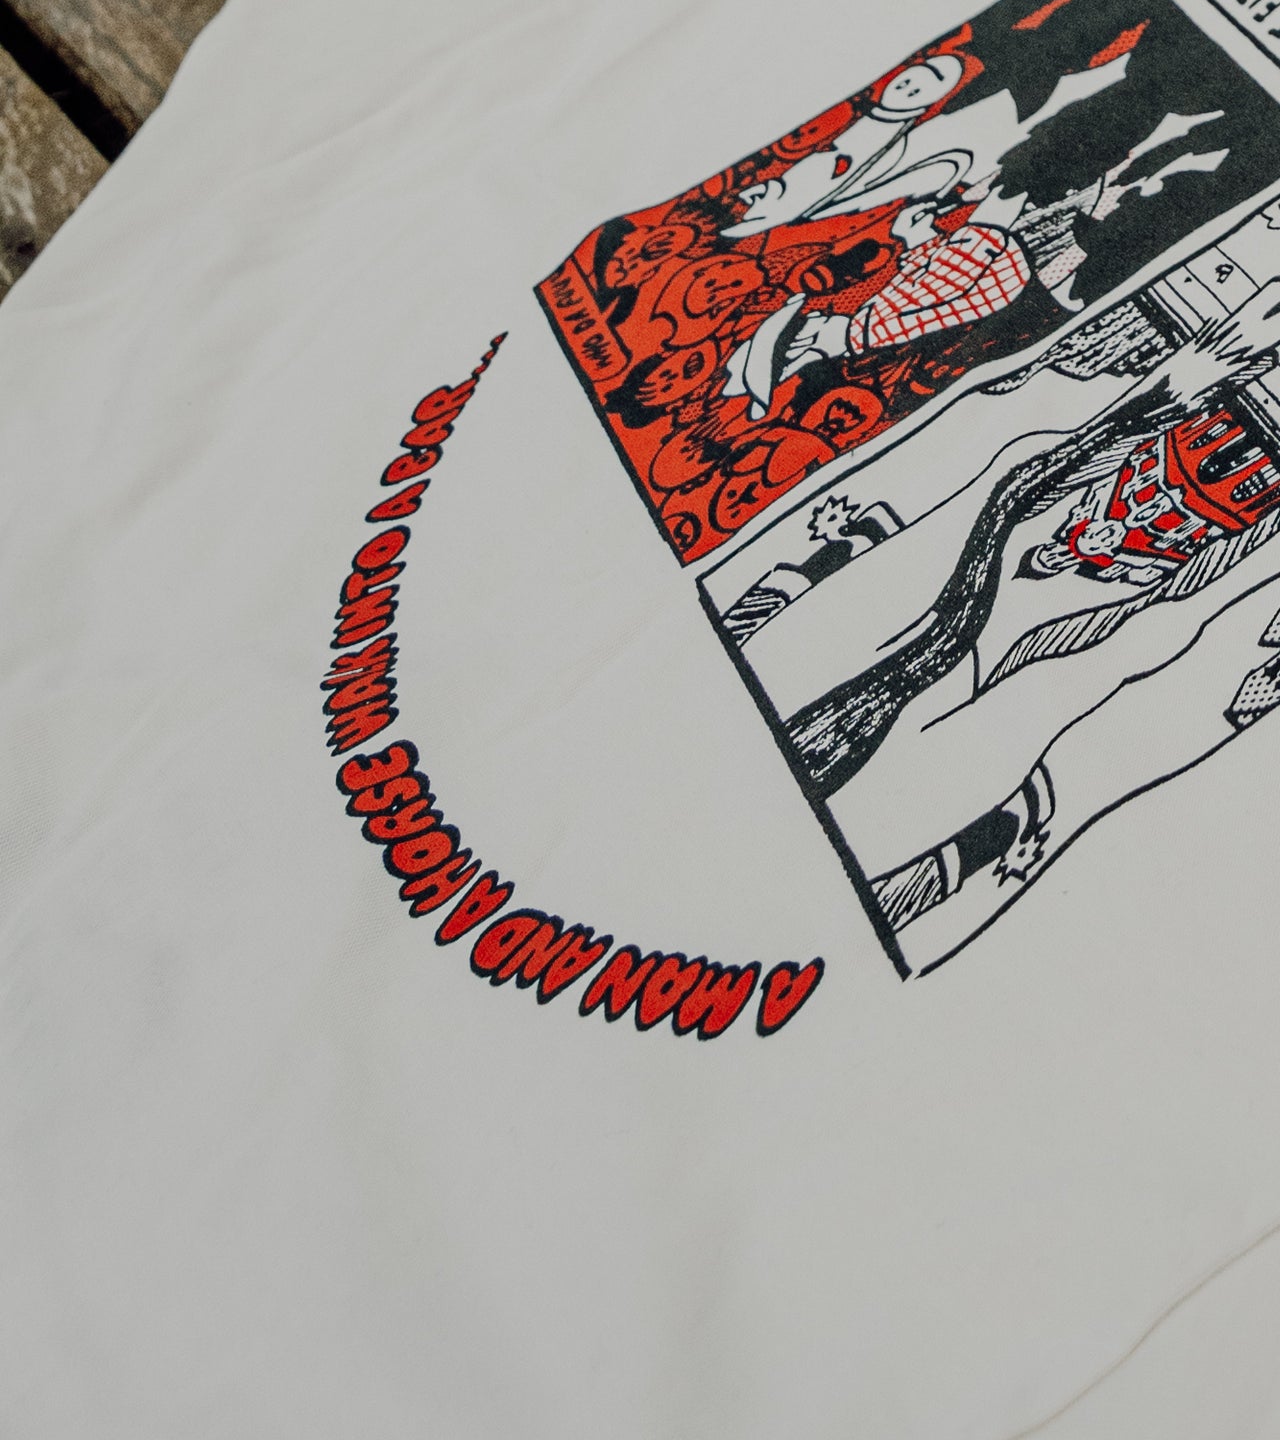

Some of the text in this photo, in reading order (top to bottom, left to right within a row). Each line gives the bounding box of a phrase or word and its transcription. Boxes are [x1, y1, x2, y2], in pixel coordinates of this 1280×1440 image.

[364, 478, 431, 523] A
[329, 524, 411, 650] INTO
[335, 739, 482, 918] HORSE
[434, 870, 515, 946] A
[470, 908, 614, 1005] AND
[578, 944, 762, 1041] MAN
[756, 956, 825, 1037] A
